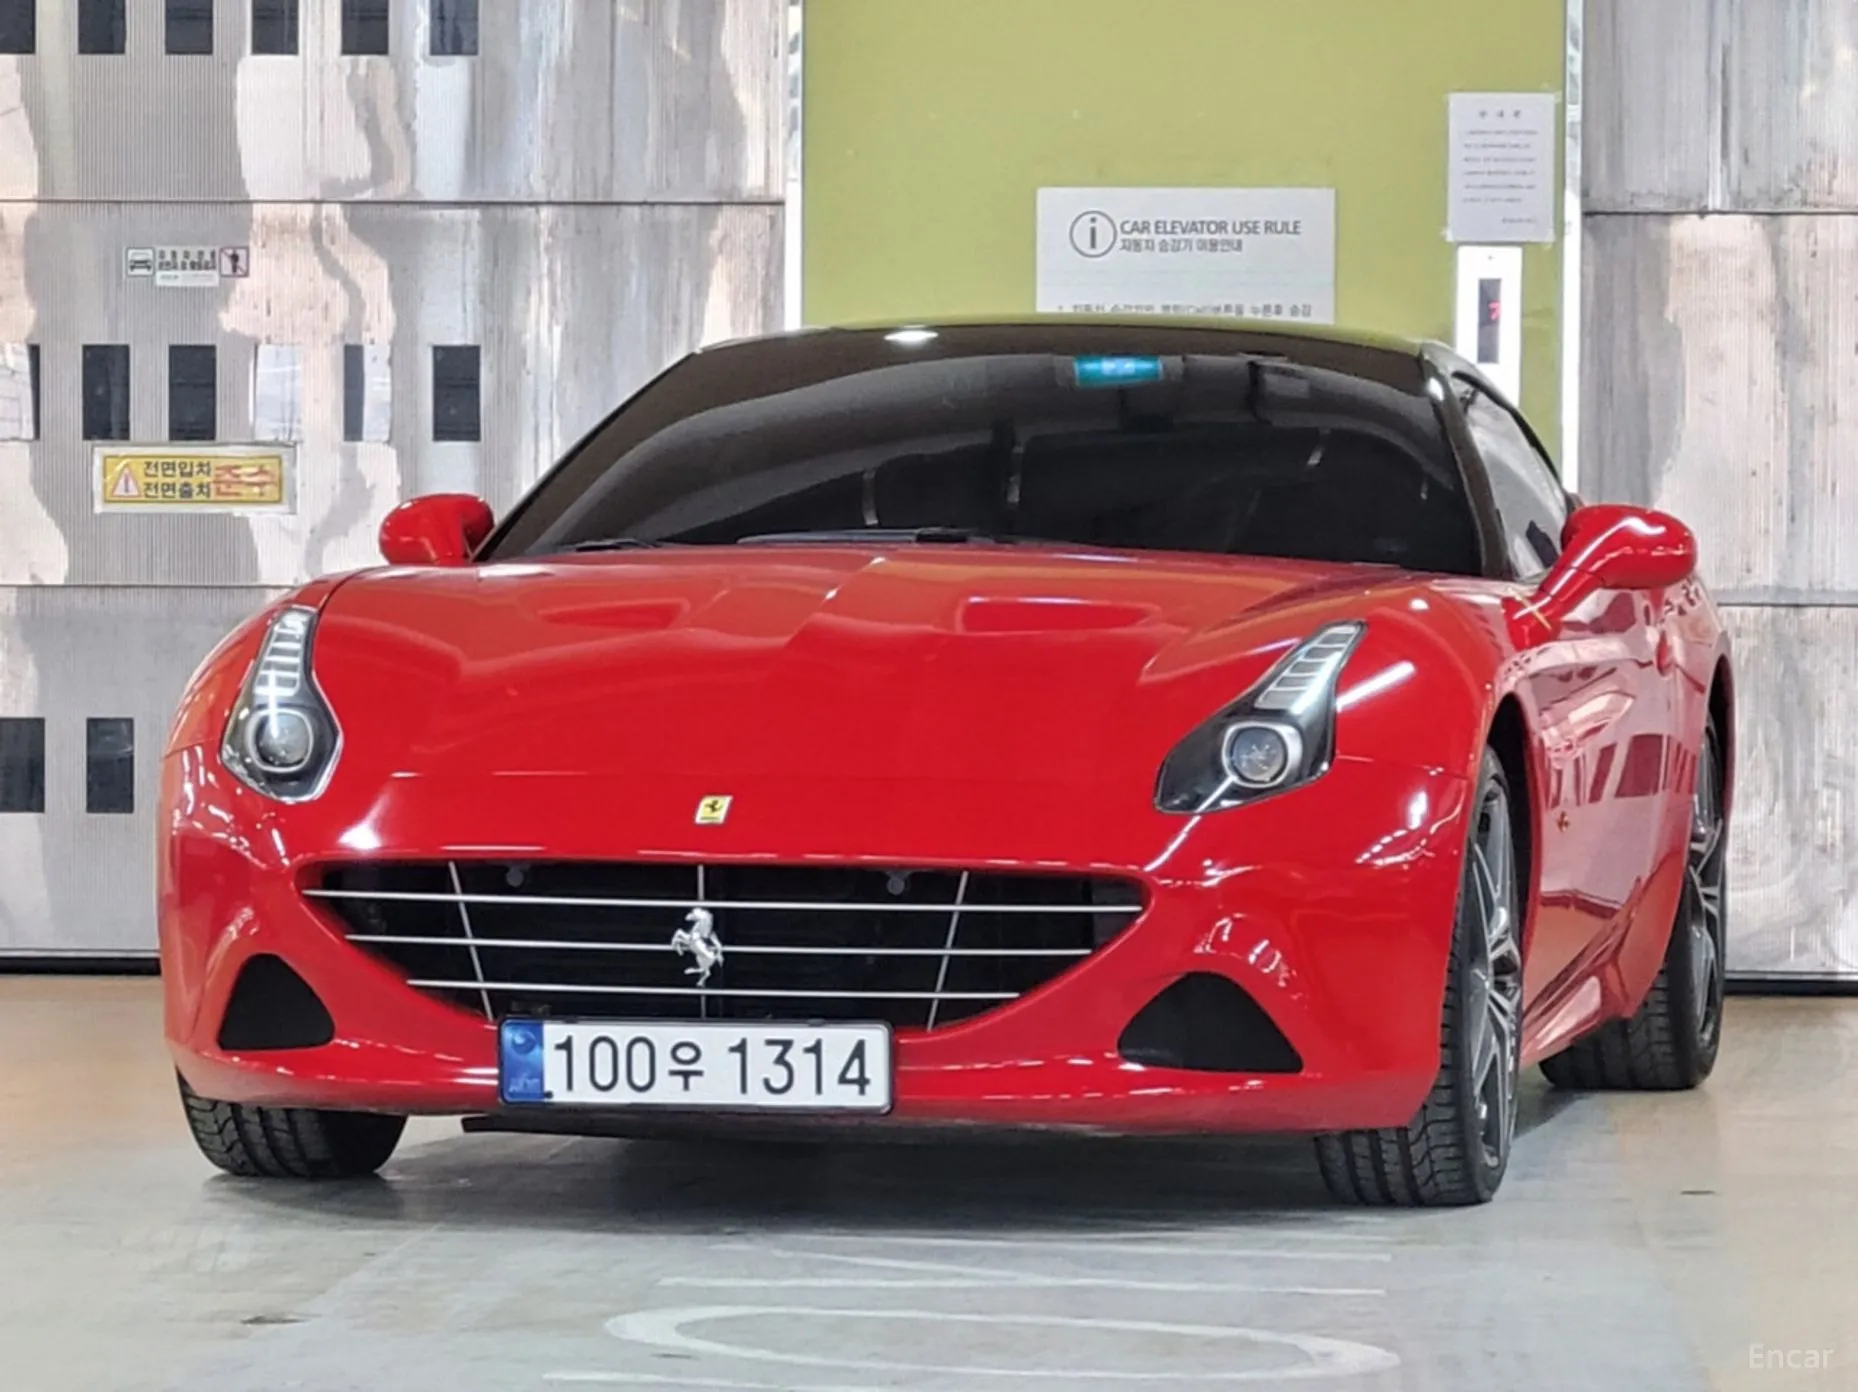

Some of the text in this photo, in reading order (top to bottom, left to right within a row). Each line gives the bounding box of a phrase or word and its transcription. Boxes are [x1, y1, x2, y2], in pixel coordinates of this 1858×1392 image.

[1120, 220, 1301, 235] CAR ELEVATOR USE RULE
[1120, 238, 1155, 252] 자동차
[1158, 238, 1193, 253] 승강기
[144, 461, 211, 478] 전면입차
[144, 482, 211, 499] 전면출차
[554, 1034, 872, 1096] 100우 1314
